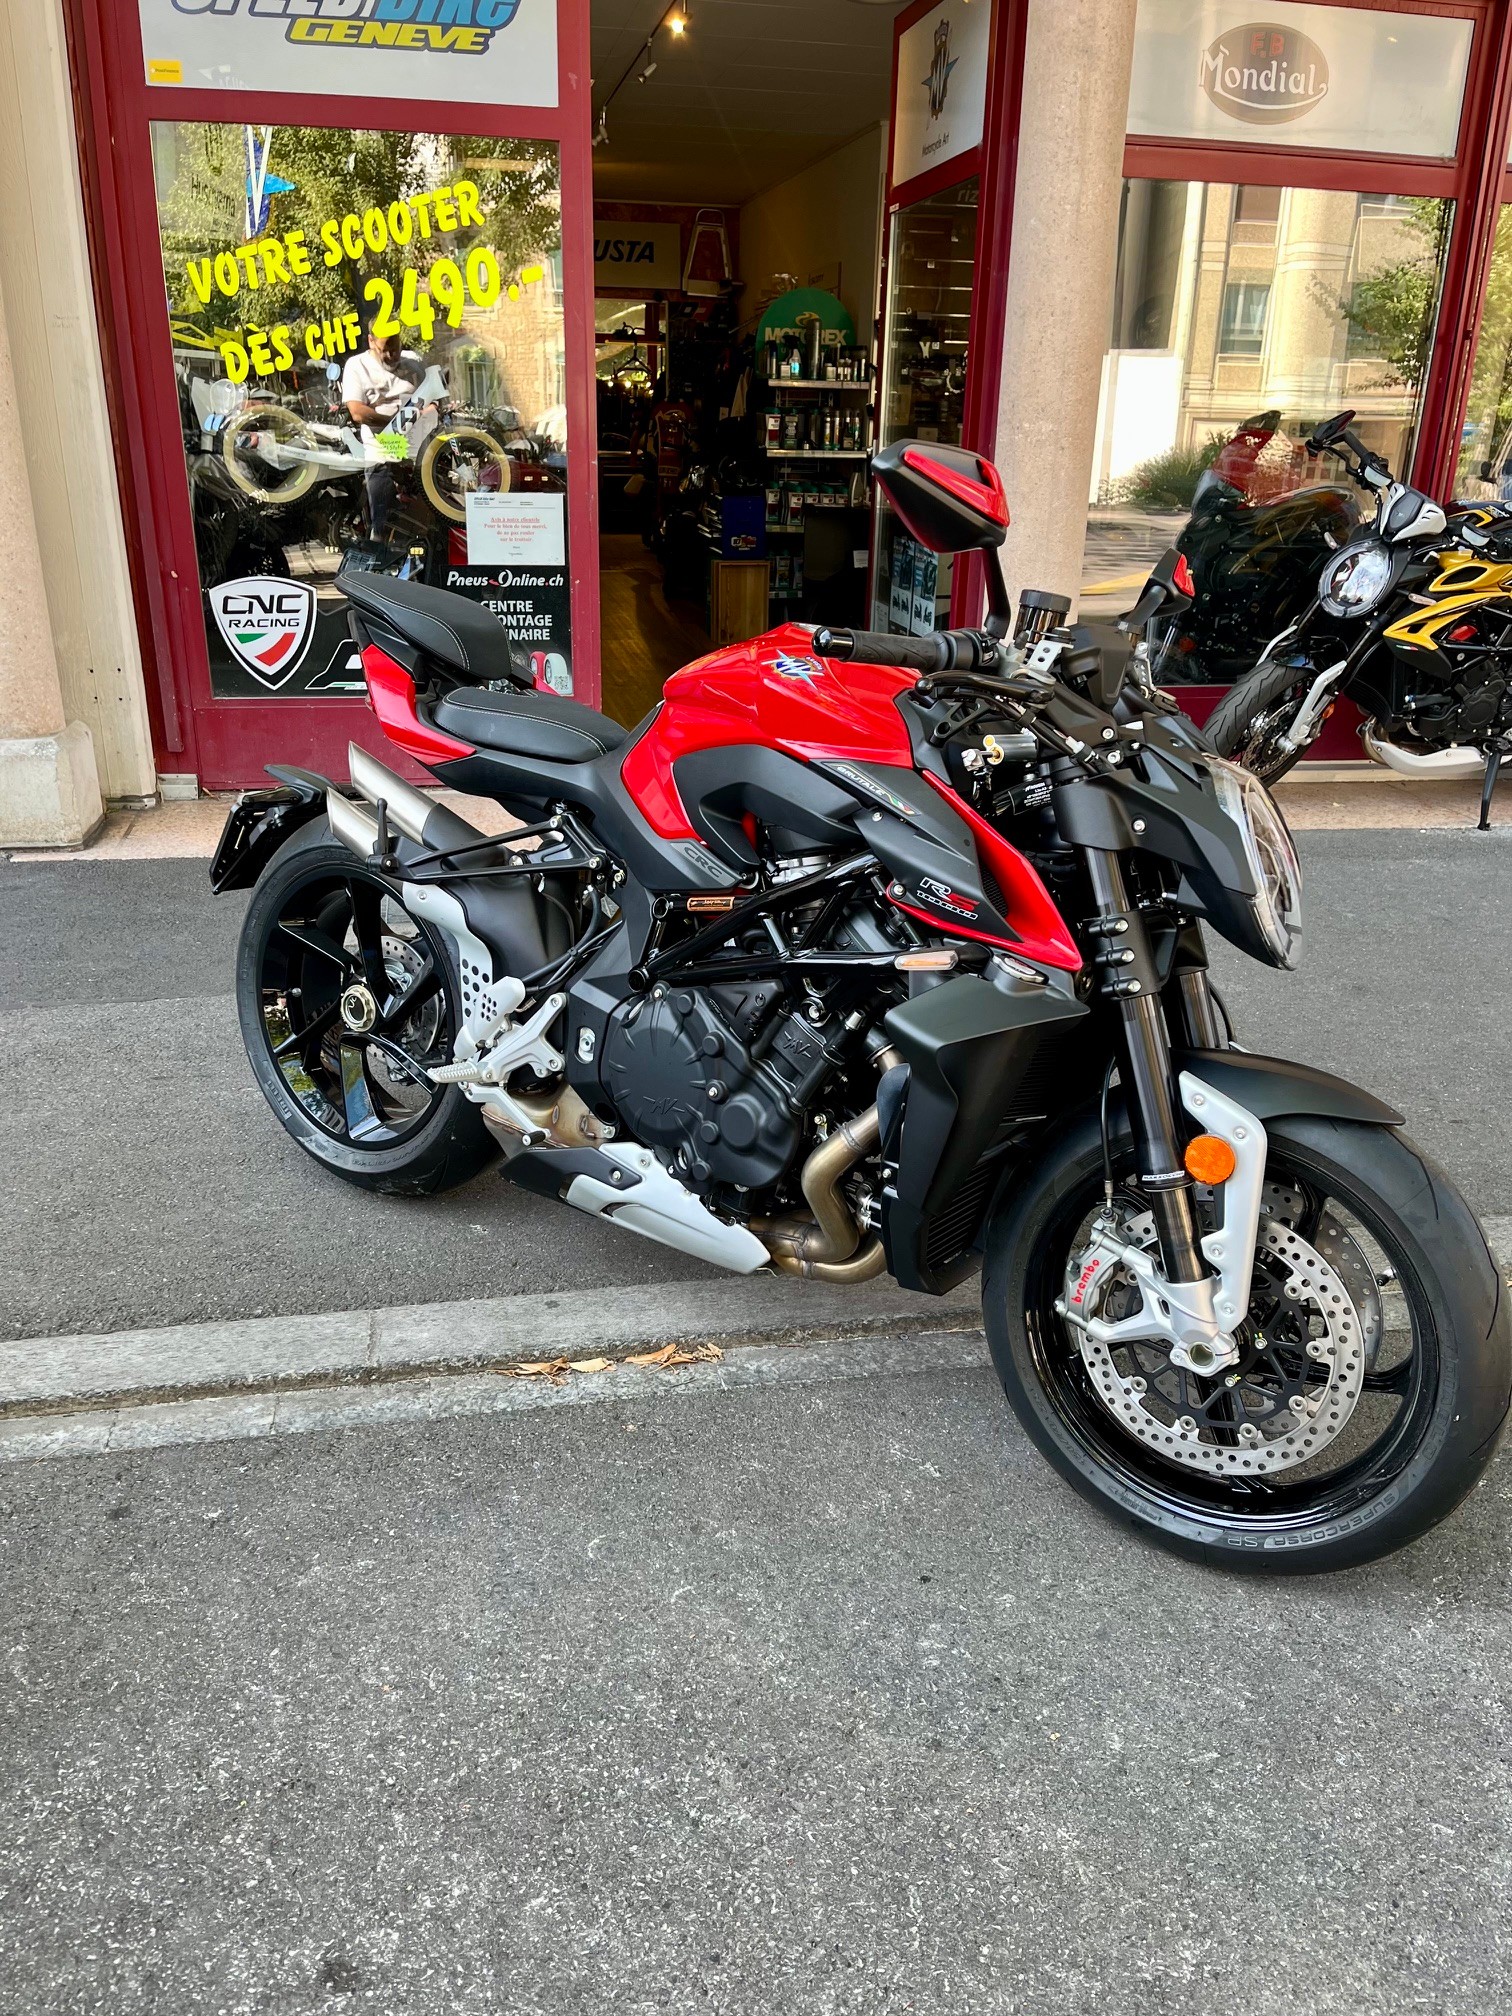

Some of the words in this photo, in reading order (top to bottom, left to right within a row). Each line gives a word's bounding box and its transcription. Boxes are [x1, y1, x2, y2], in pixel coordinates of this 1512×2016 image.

[288, 17, 491, 51] GENEVE
[1199, 45, 1329, 109] Mondial
[942, 133, 950, 146] Art
[187, 229, 312, 304] VOTRE
[321, 180, 486, 267] SCOOTER
[594, 240, 655, 263] USTA
[220, 323, 294, 386] DÈS
[305, 312, 362, 361] CHF
[765, 327, 849, 345] MOTREX
[222, 594, 304, 615] CNC
[228, 618, 300, 629] RACING
[497, 614, 553, 627] ONTAGE
[836, 766, 885, 796] BRUTALE
[684, 846, 723, 878] CRC
[1071, 1259, 1100, 1304] brembo
[1273, 1493, 1396, 1547] SUPERCORSA
[1227, 1535, 1258, 1547] SP
